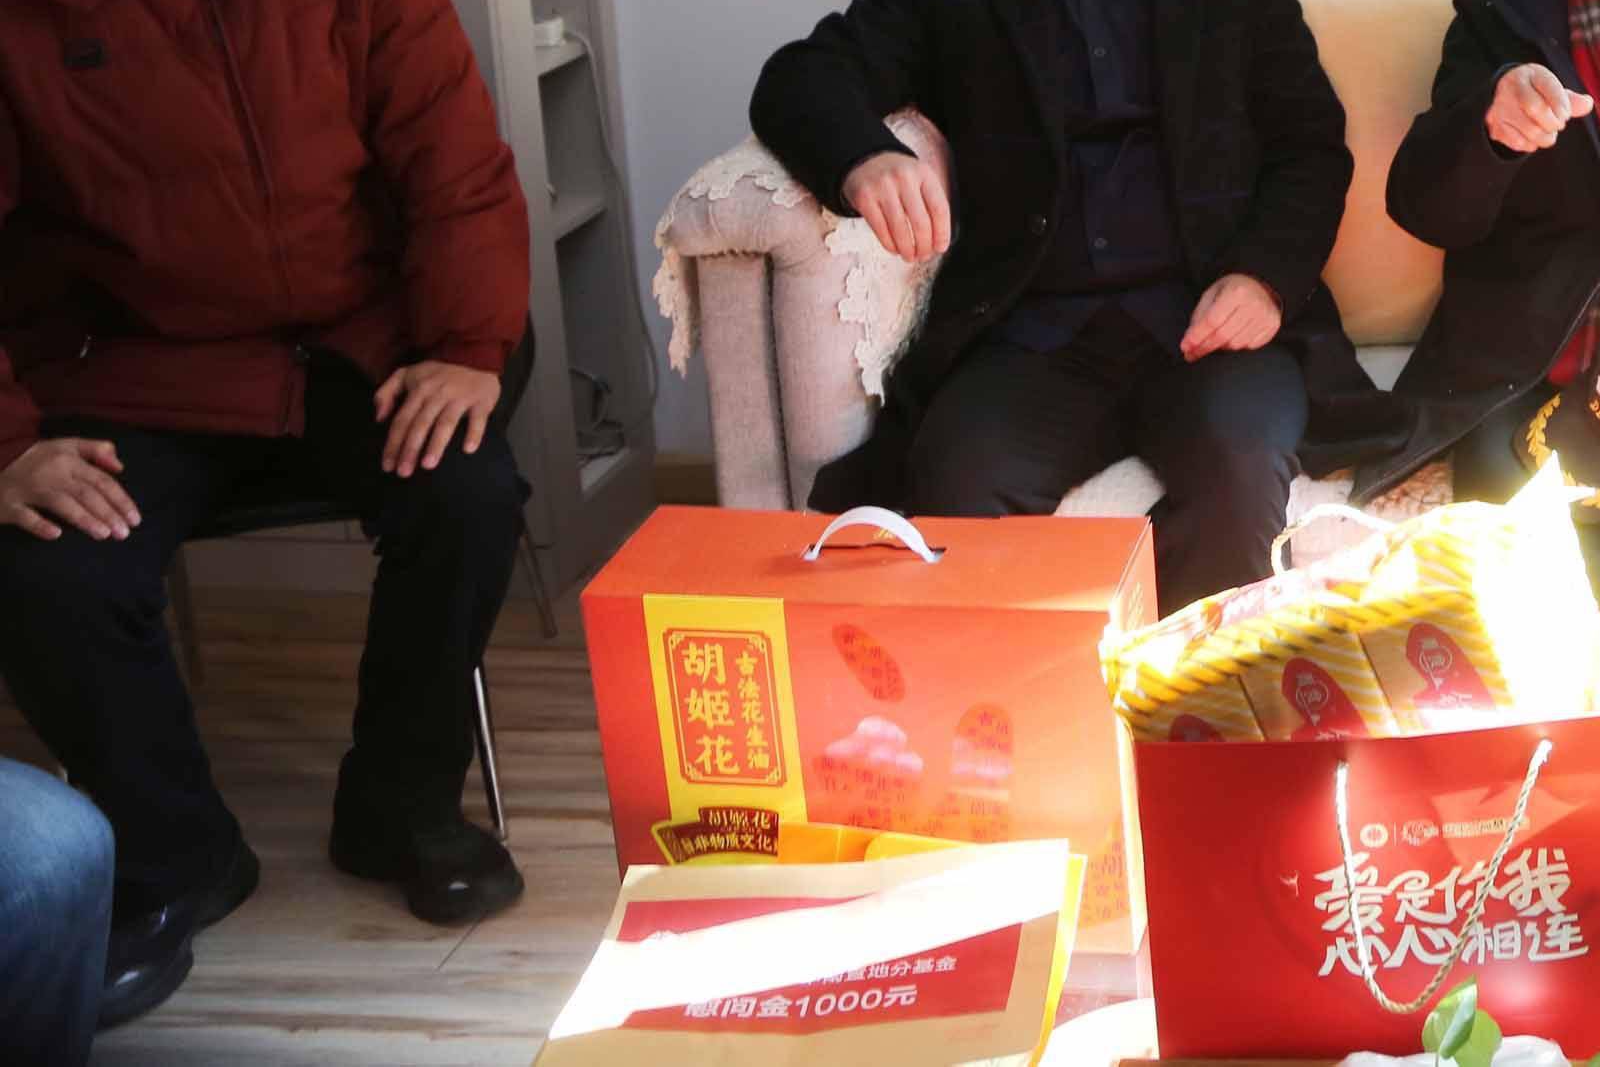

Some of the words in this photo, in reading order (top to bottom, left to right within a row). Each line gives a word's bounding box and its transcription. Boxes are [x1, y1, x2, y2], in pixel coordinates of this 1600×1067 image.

[682, 642, 740, 774] 胡姬花
[735, 650, 770, 769] 古法花生油
[1314, 848, 1571, 934] 爱是你我
